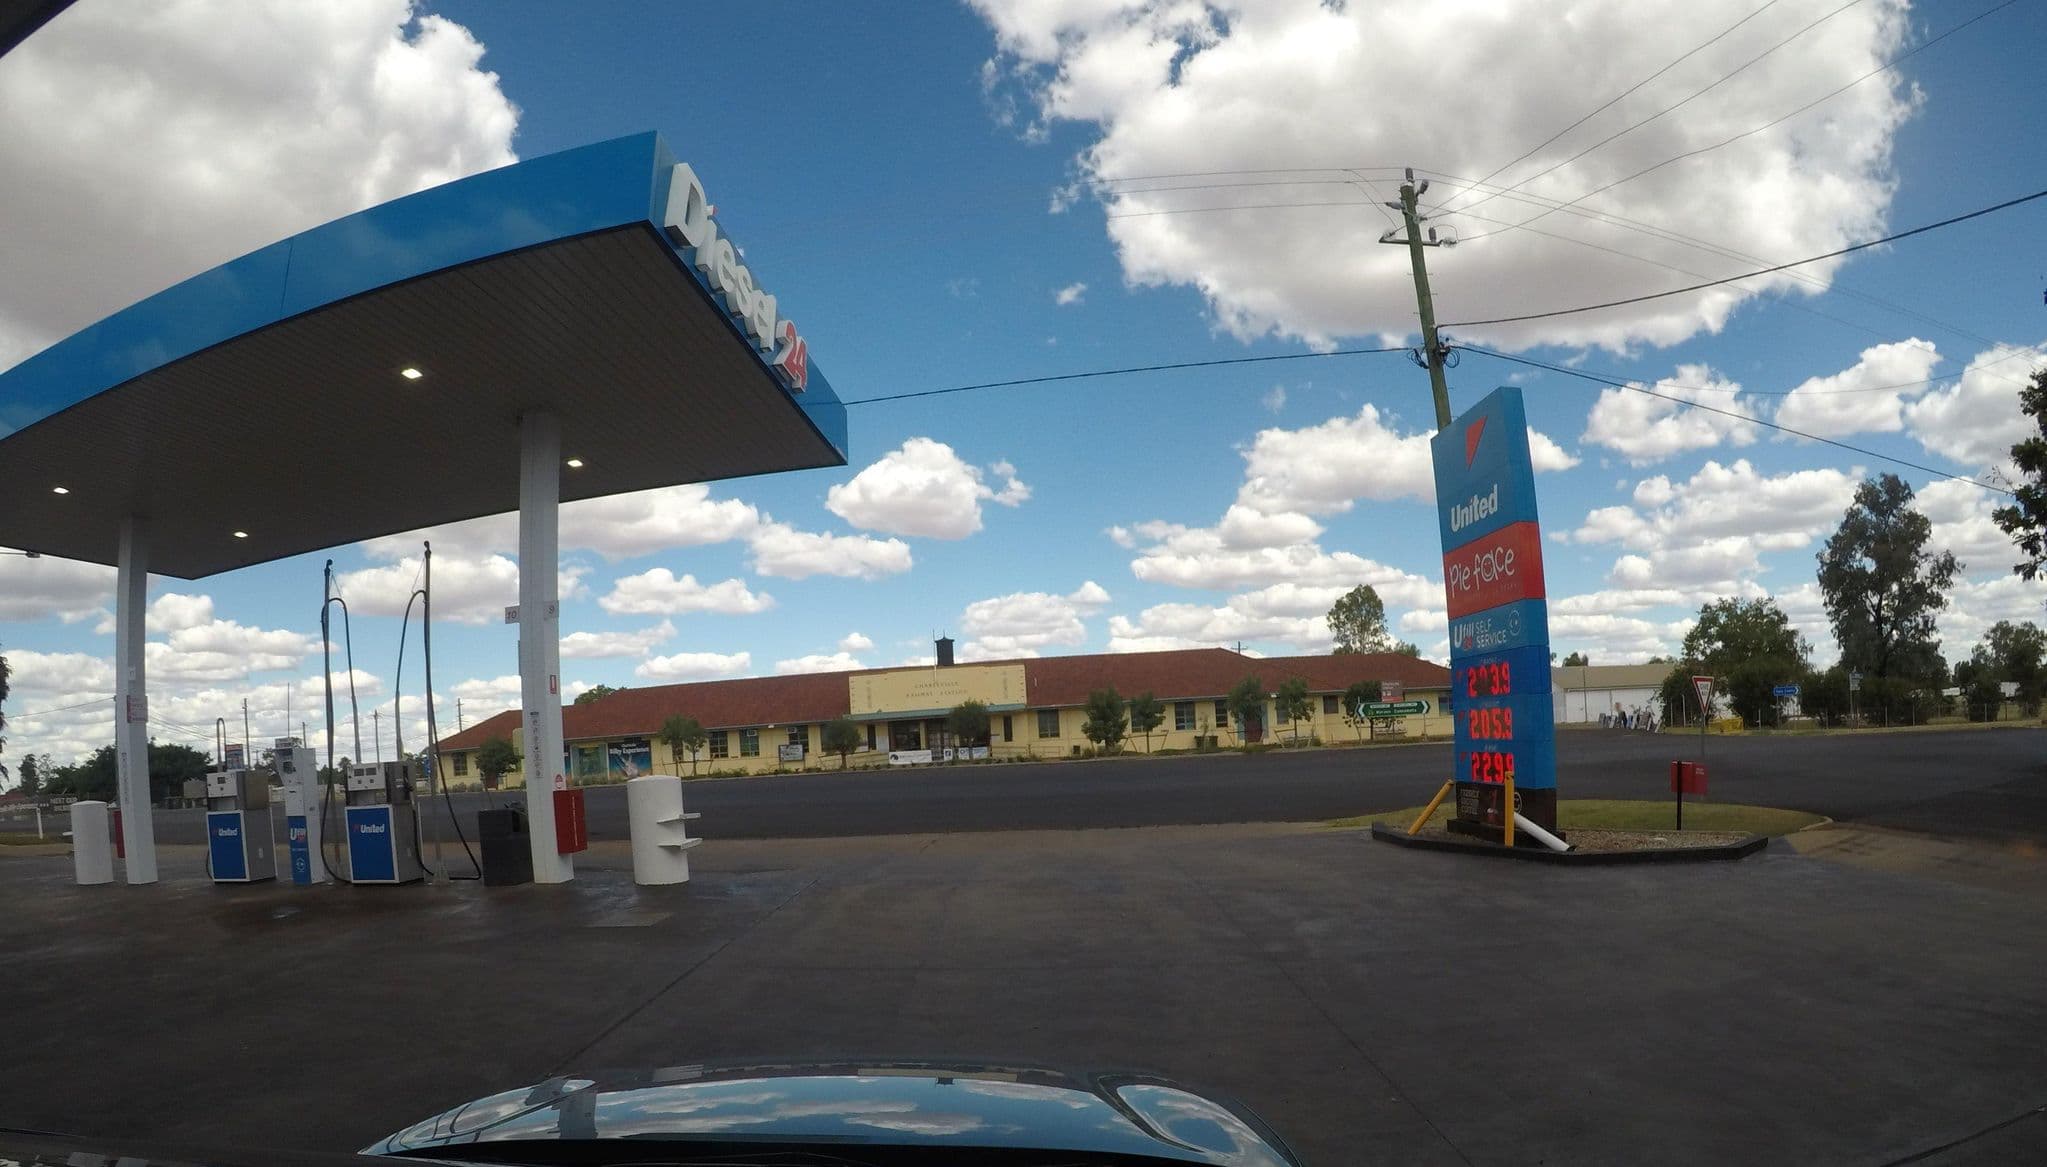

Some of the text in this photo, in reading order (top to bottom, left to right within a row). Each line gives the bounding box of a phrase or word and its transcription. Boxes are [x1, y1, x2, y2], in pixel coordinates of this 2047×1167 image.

[664, 162, 808, 394] Diesel 24
[1450, 483, 1499, 533] United
[1449, 546, 1515, 598] Pie face
[1475, 618, 1492, 635] SELF
[1476, 629, 1507, 649] SERVICE
[360, 824, 385, 834] United
